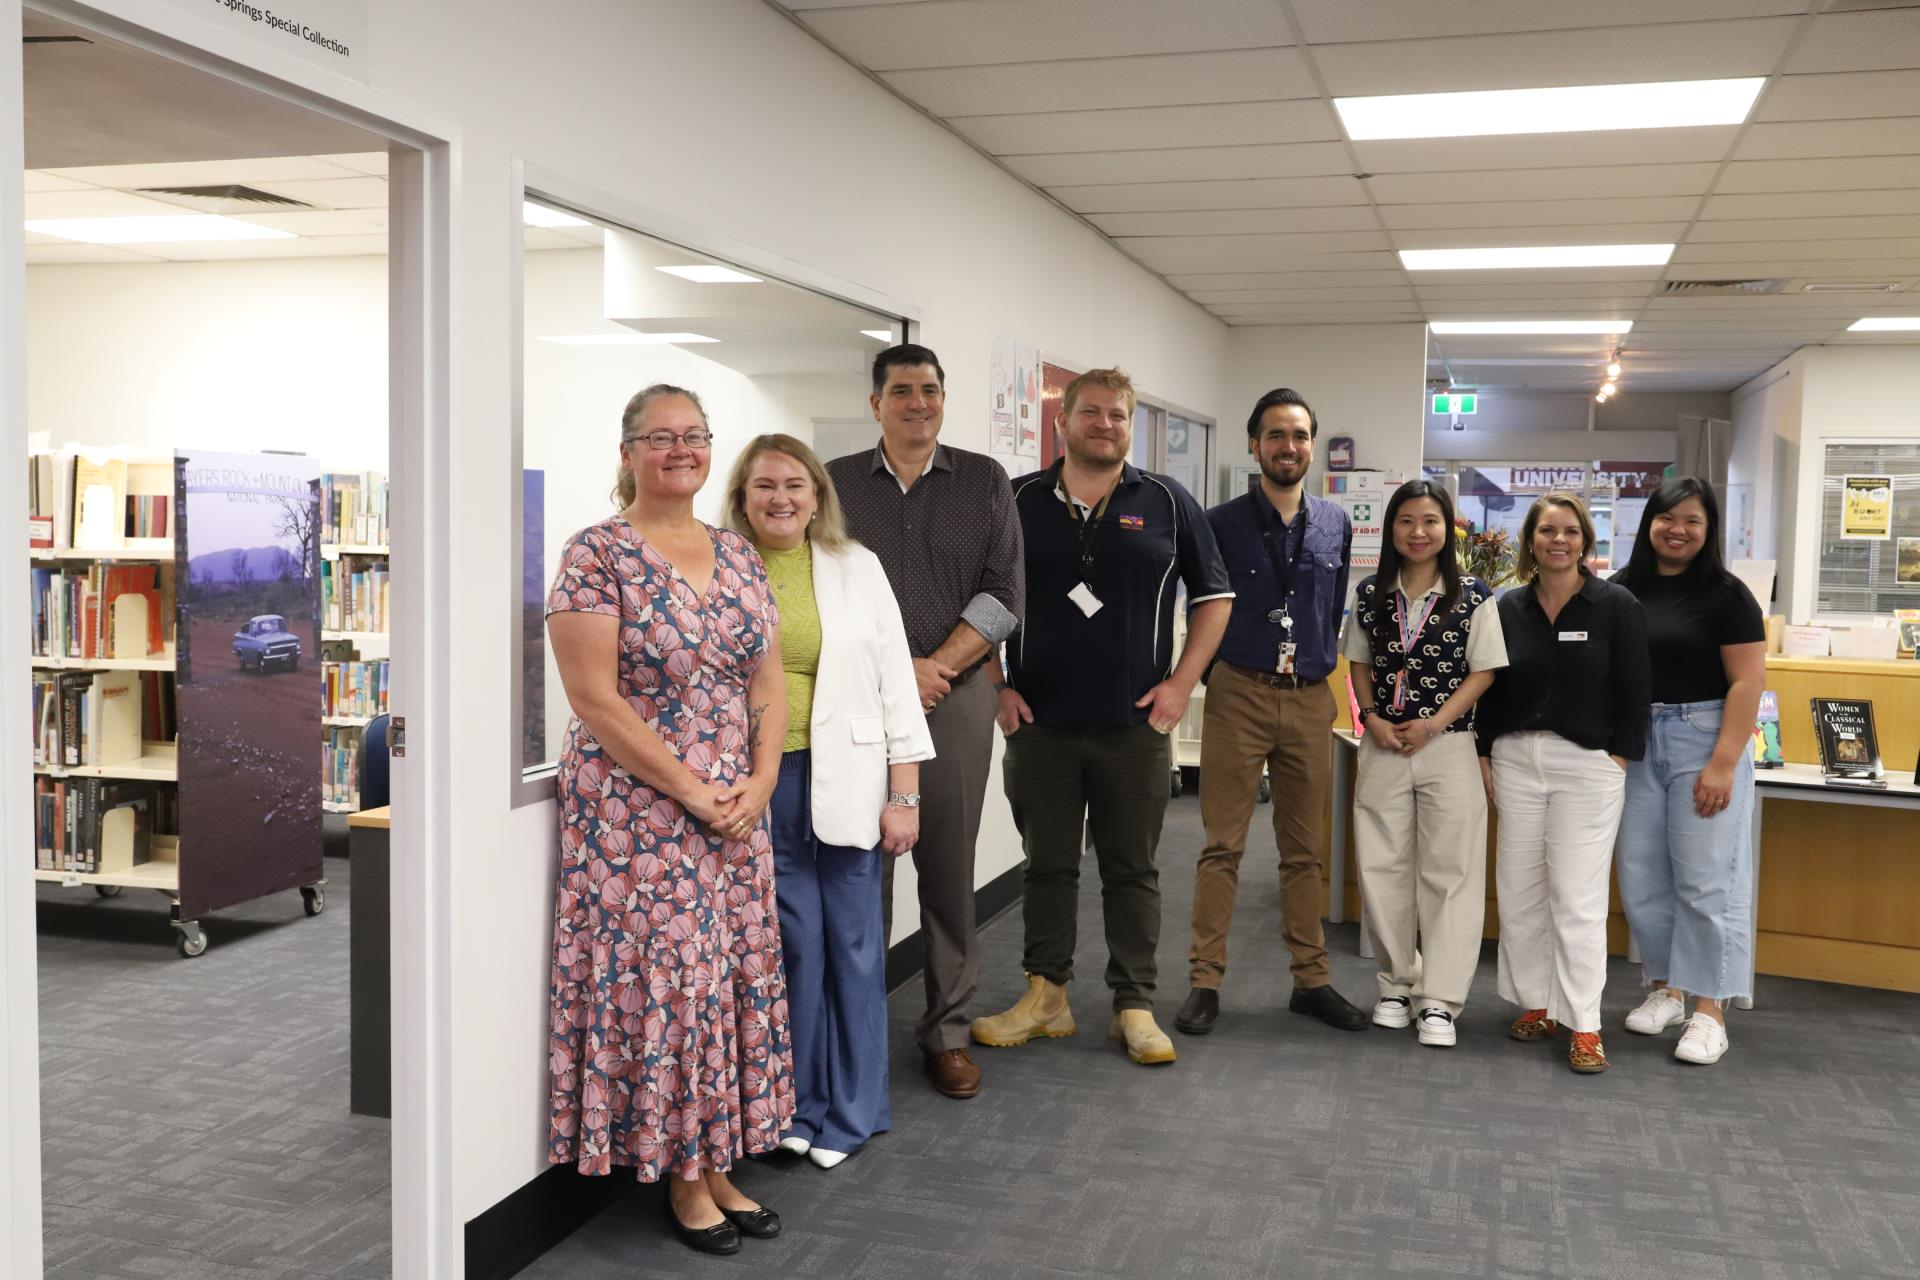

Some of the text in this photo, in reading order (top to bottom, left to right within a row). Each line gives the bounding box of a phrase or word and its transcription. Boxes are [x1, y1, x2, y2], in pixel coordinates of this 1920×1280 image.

[265, 10, 300, 37] Special
[302, 26, 350, 57] Collection
[222, 468, 251, 487] ROCK
[1827, 702, 1860, 713] WOMEN
[1824, 713, 1865, 724] CLASSICAL
[1831, 723, 1862, 733] WORLD
